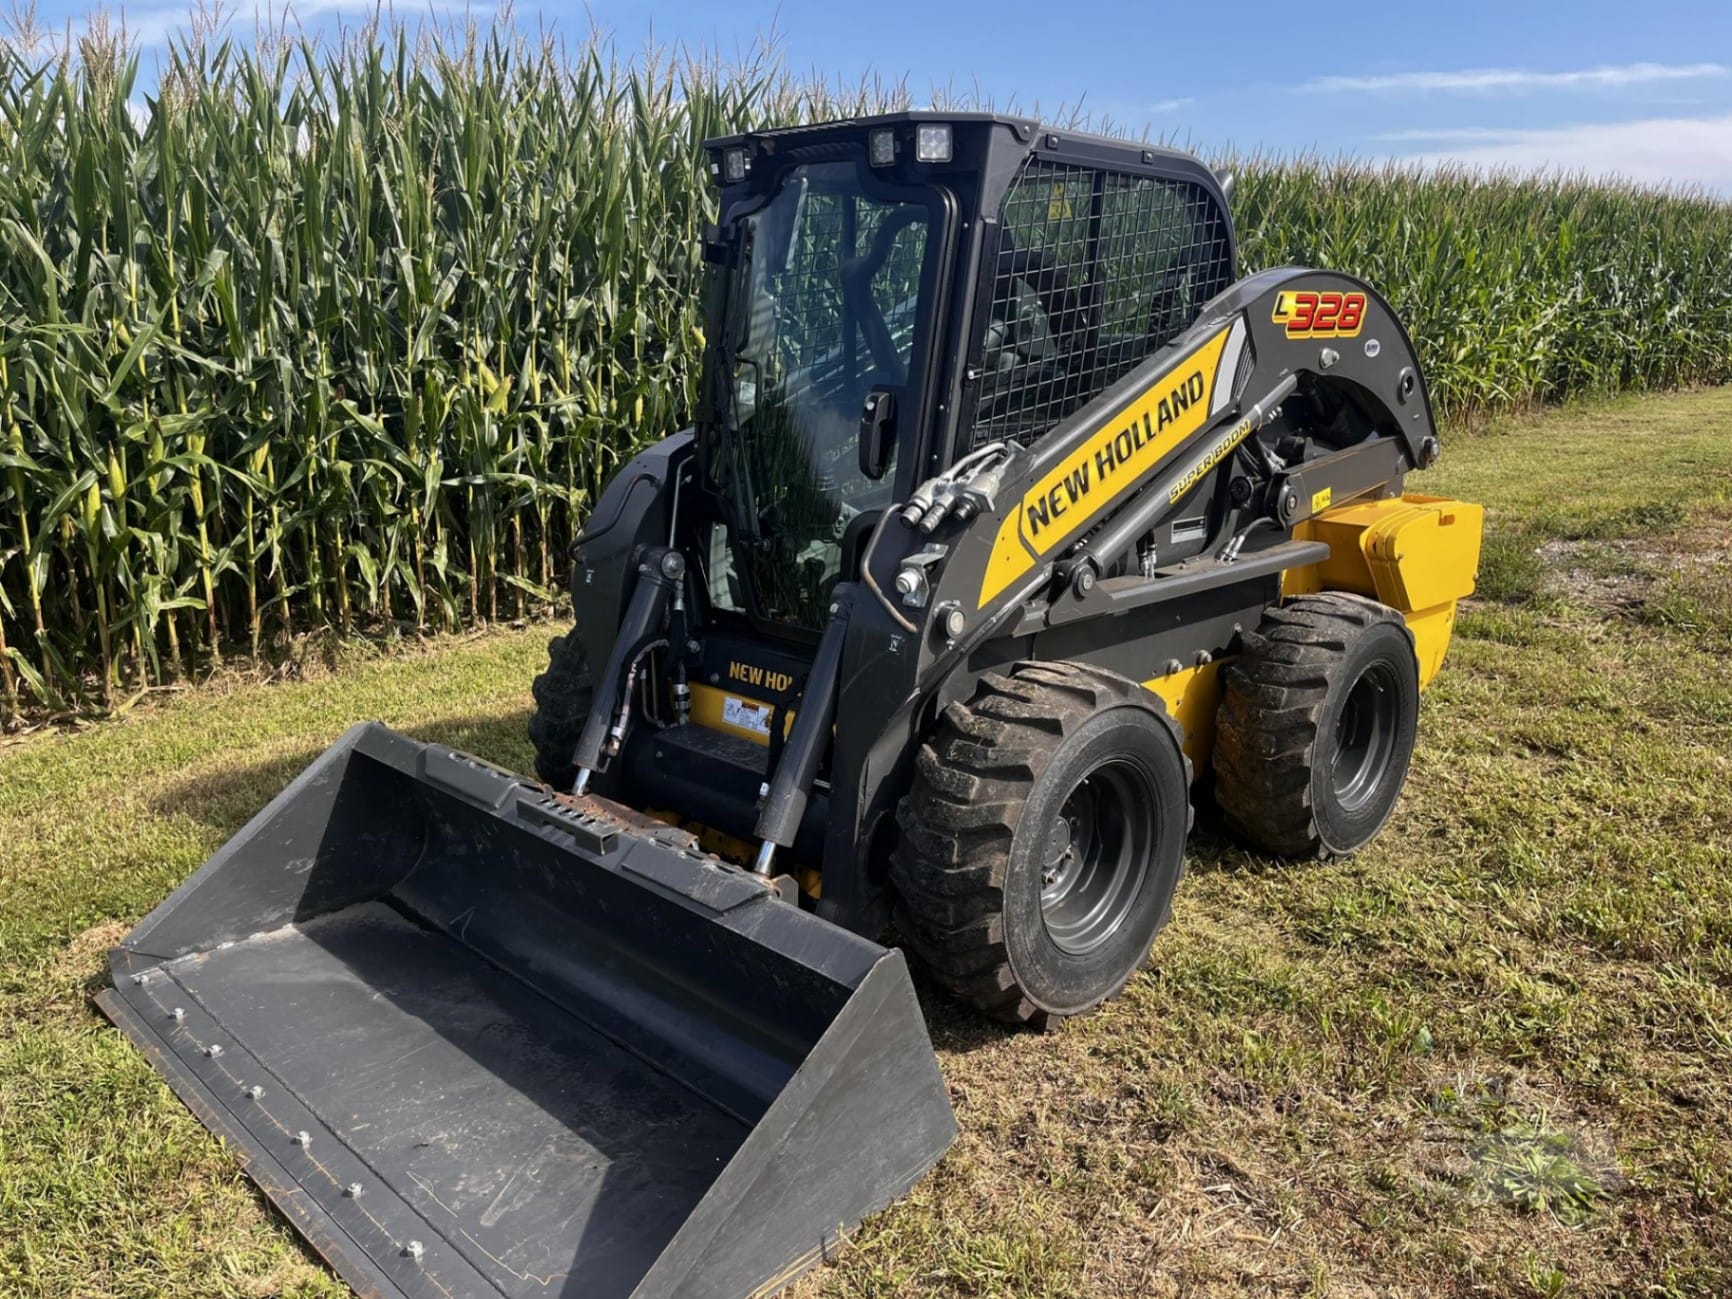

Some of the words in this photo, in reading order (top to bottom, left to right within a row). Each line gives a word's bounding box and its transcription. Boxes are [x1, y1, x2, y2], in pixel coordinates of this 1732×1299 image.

[1273, 292, 1366, 336] L328
[1027, 458, 1091, 537] NEW
[1094, 370, 1204, 481] HOLLAND
[1169, 453, 1213, 502] SUPER
[1213, 419, 1251, 461] BOOM
[729, 660, 763, 686] NEW
[765, 671, 793, 692] HO
